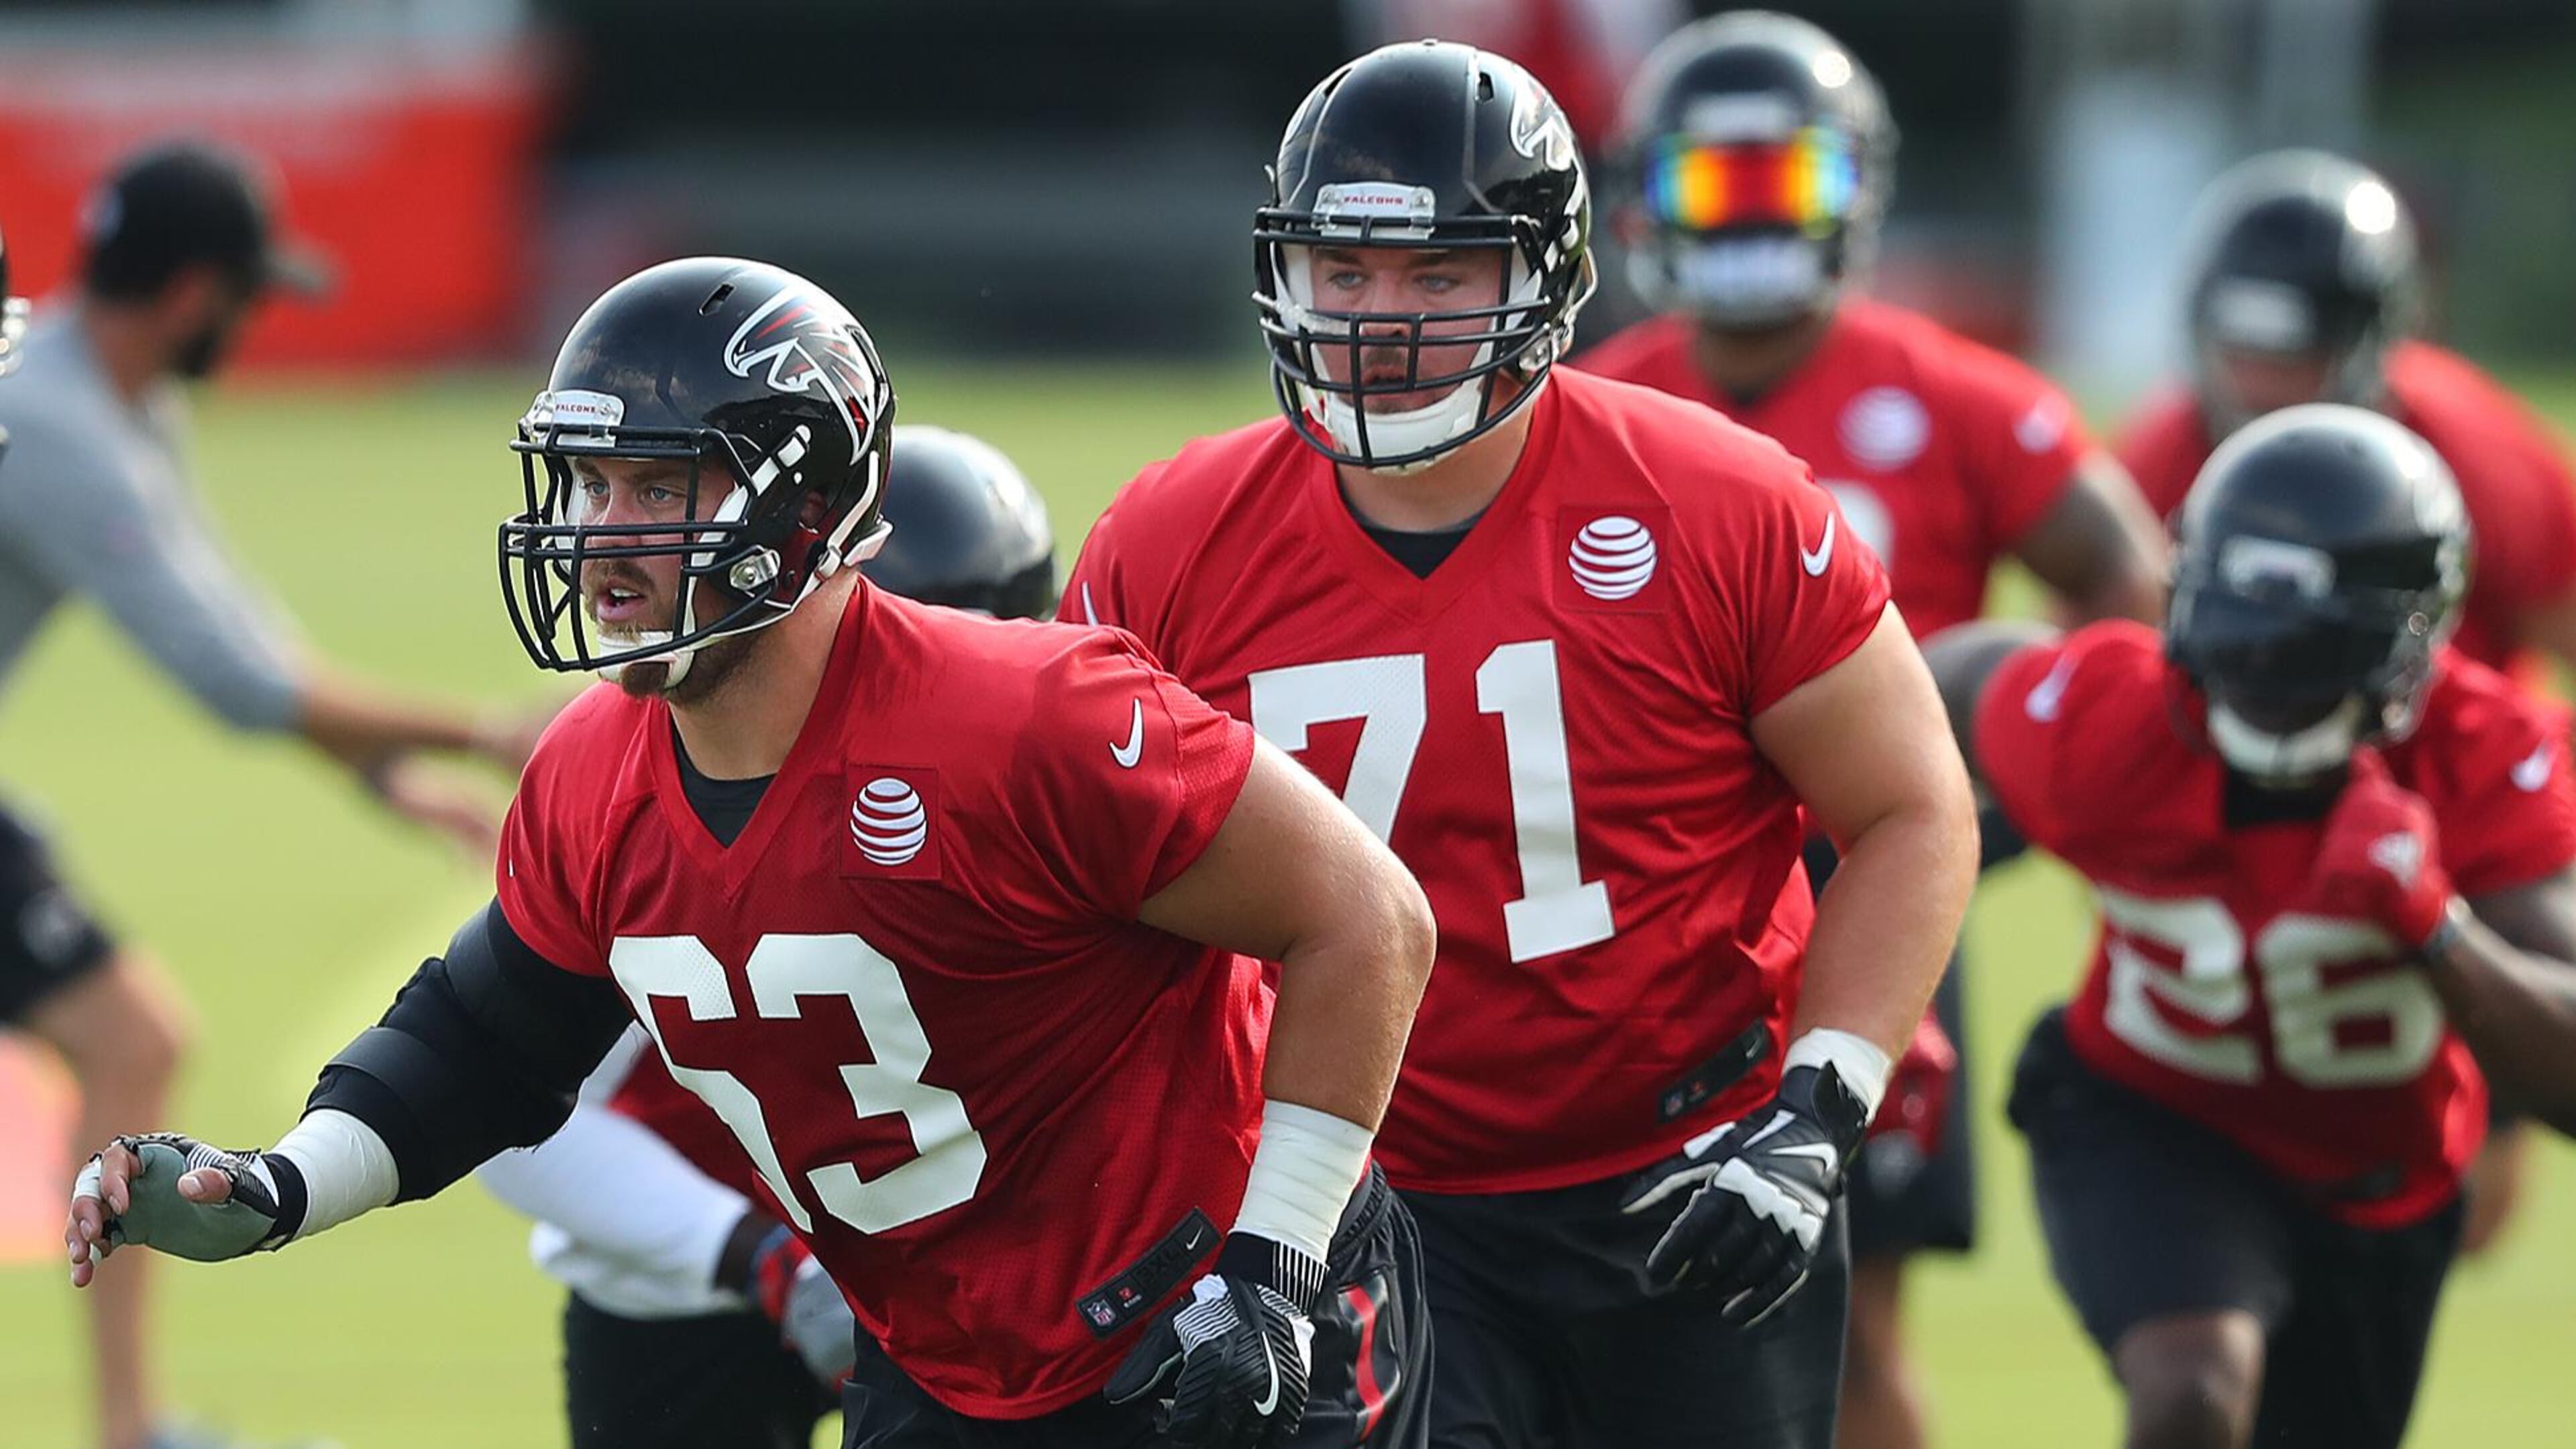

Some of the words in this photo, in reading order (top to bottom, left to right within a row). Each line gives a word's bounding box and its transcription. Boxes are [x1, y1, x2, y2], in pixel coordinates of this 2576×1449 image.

[1344, 196, 1403, 205] FALCONS
[555, 405, 596, 413] FALCONS
[1247, 639, 1616, 964] 71
[608, 932, 988, 1235] 63
[2096, 885, 2446, 1089] 26
